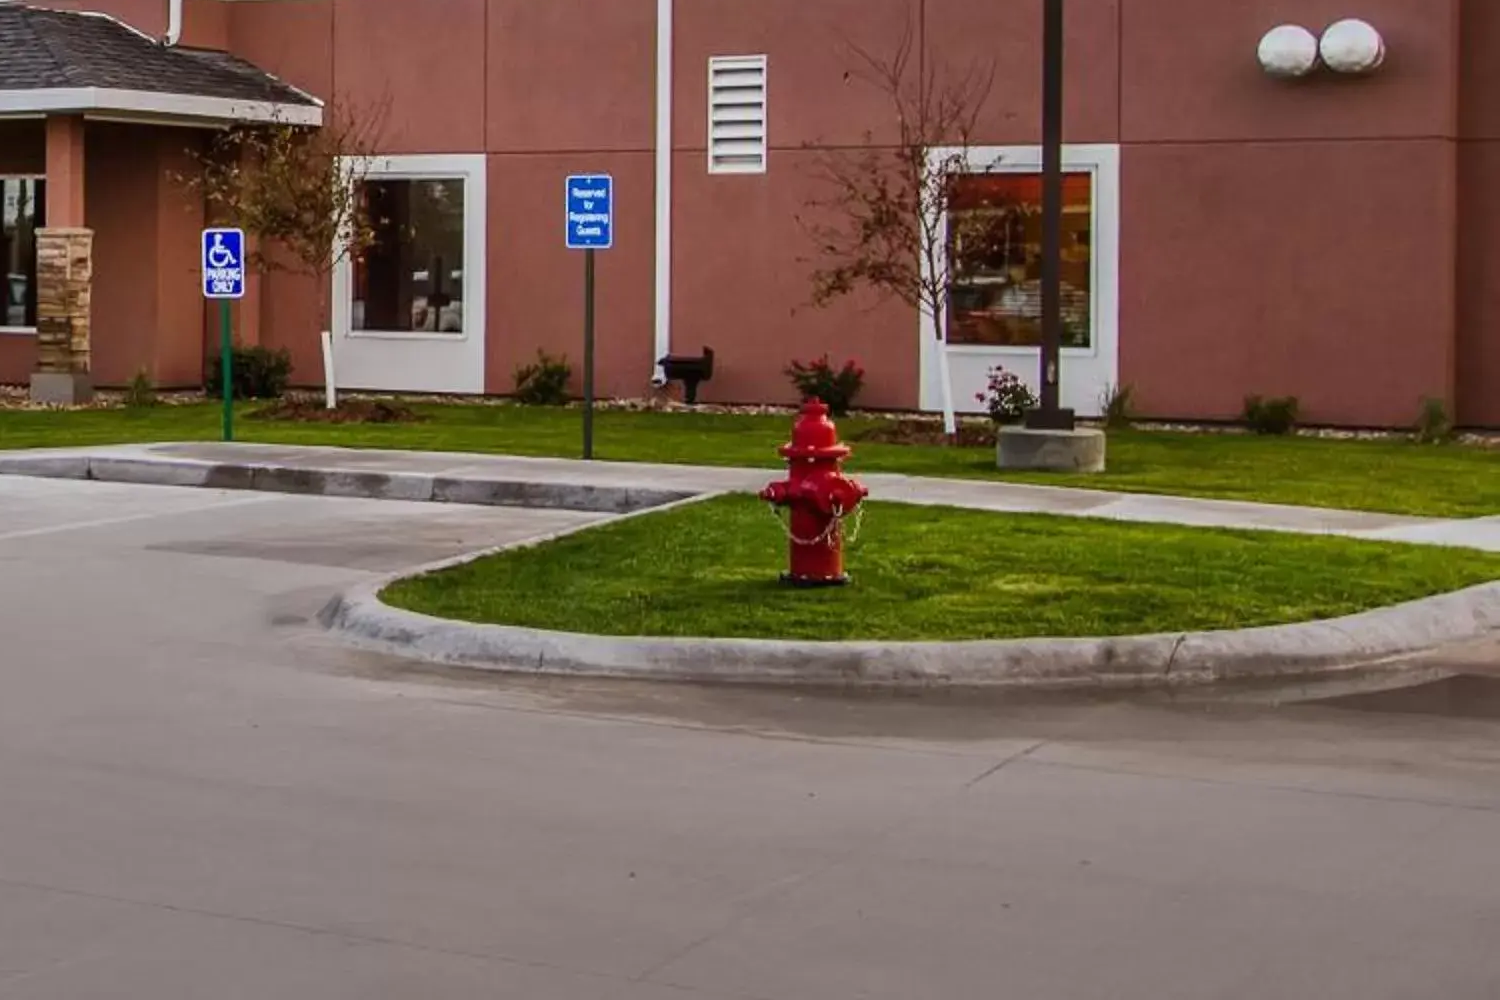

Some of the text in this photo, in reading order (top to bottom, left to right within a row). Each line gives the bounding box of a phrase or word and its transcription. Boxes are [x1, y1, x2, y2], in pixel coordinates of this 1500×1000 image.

[572, 187, 606, 198] Reserved
[583, 199, 595, 210] for
[207, 268, 241, 281] PARKING
[211, 280, 235, 293] ONLY
